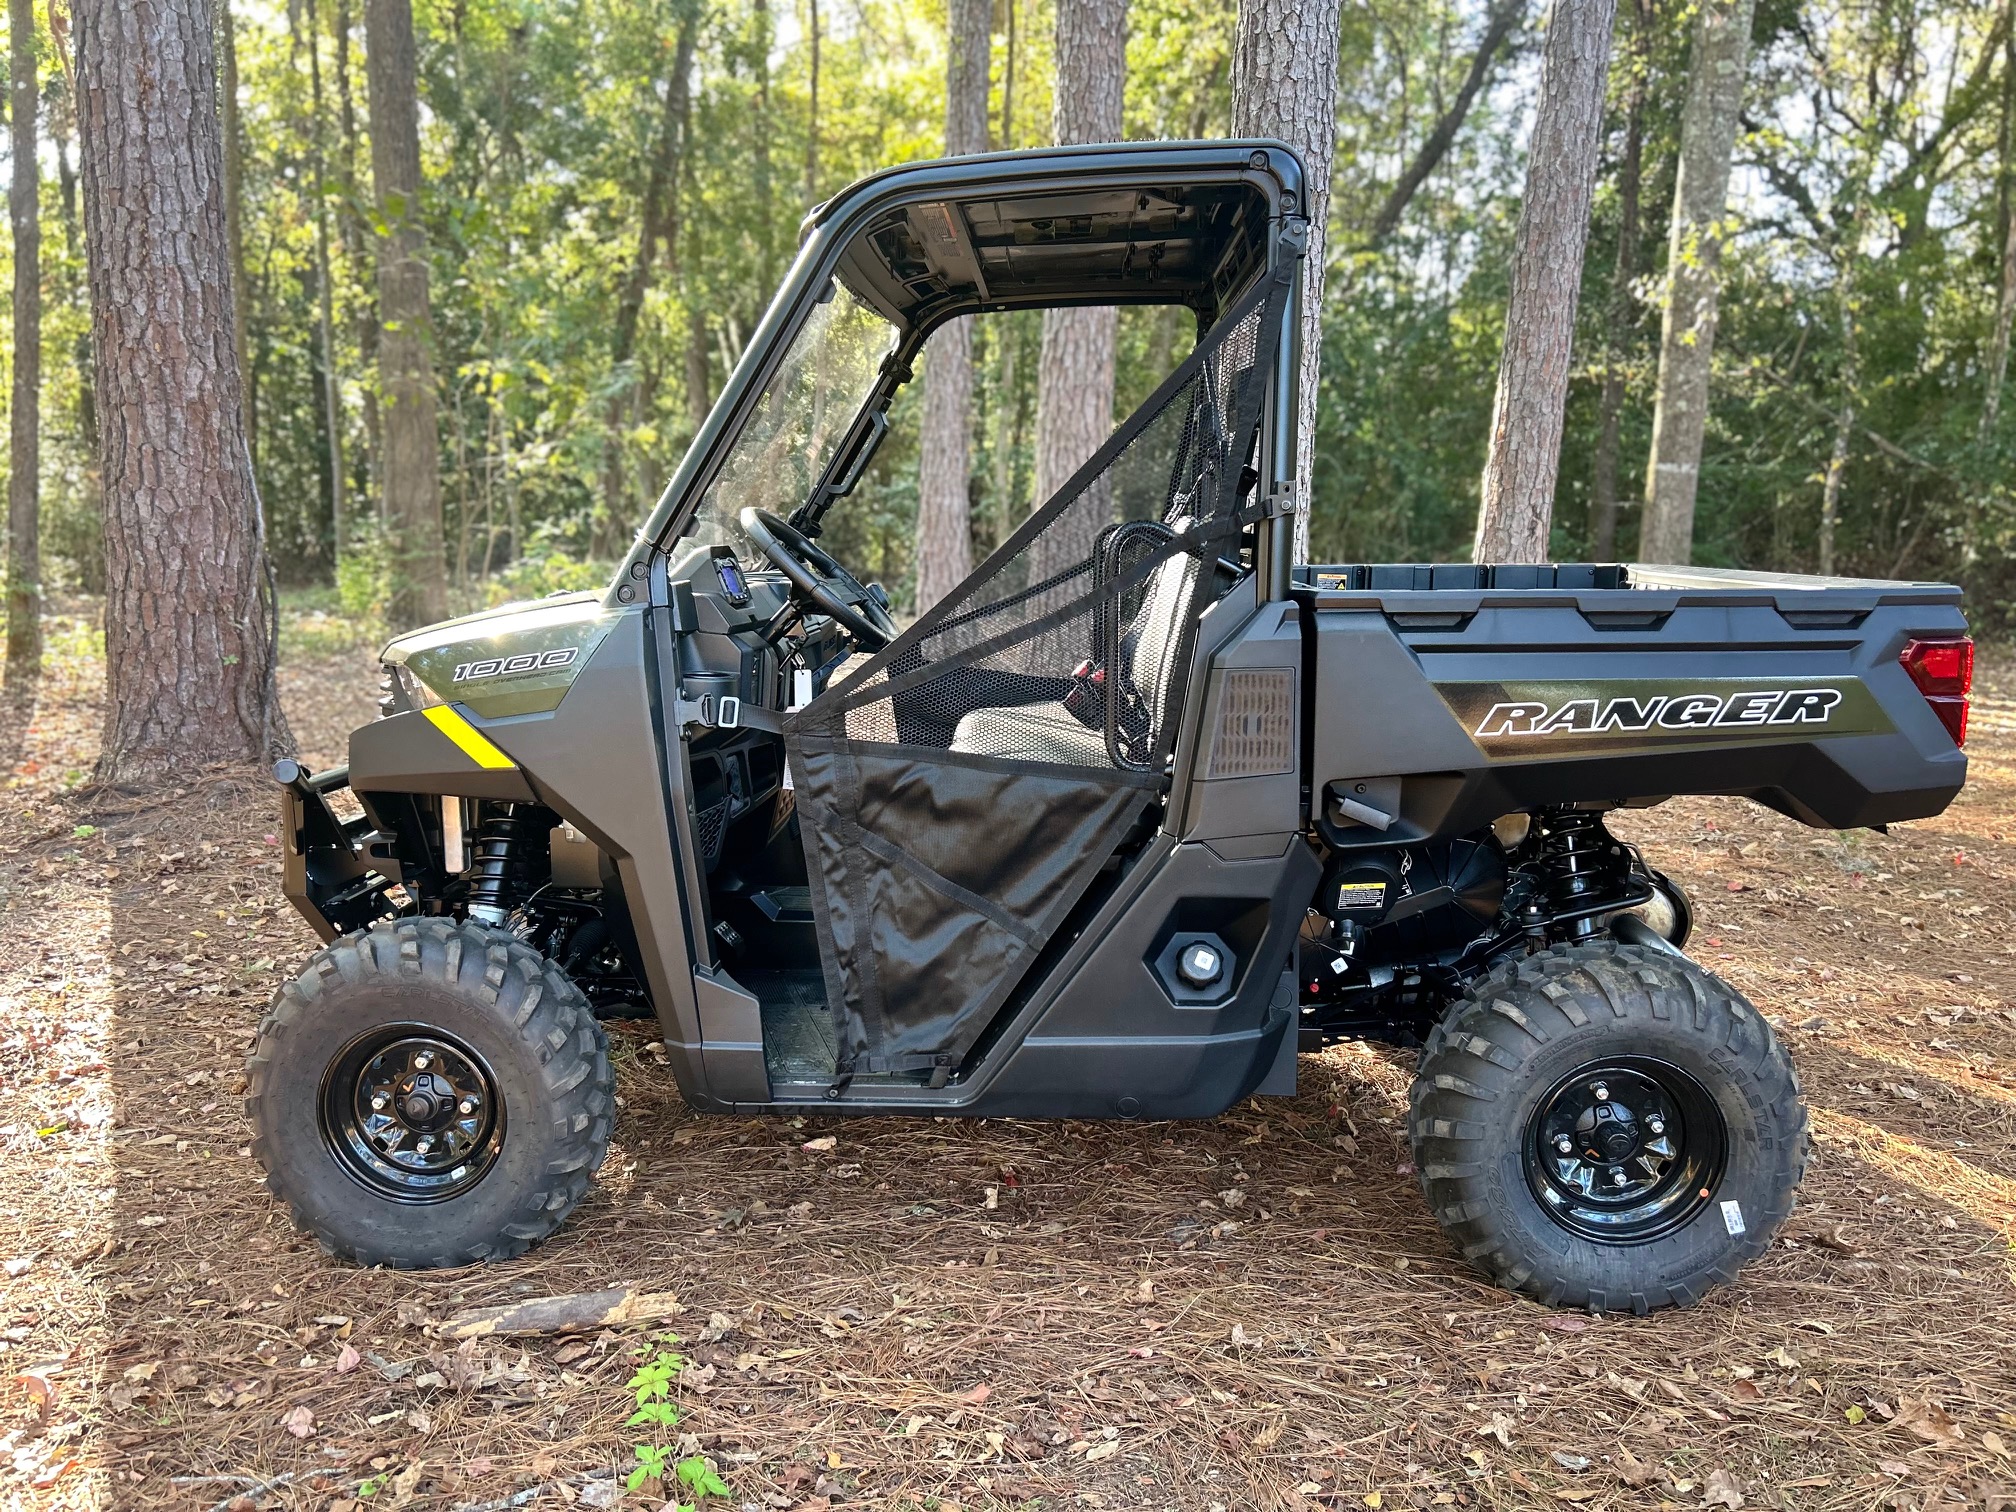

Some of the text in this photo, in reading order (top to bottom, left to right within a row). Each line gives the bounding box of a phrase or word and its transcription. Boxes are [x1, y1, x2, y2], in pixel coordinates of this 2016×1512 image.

[453, 647, 579, 682] 1000
[454, 682, 489, 690] SINGLE
[493, 673, 547, 684] OVERHEAD
[1475, 688, 1842, 736] RANGER
[1707, 1047, 1774, 1152] CARLSTAR
